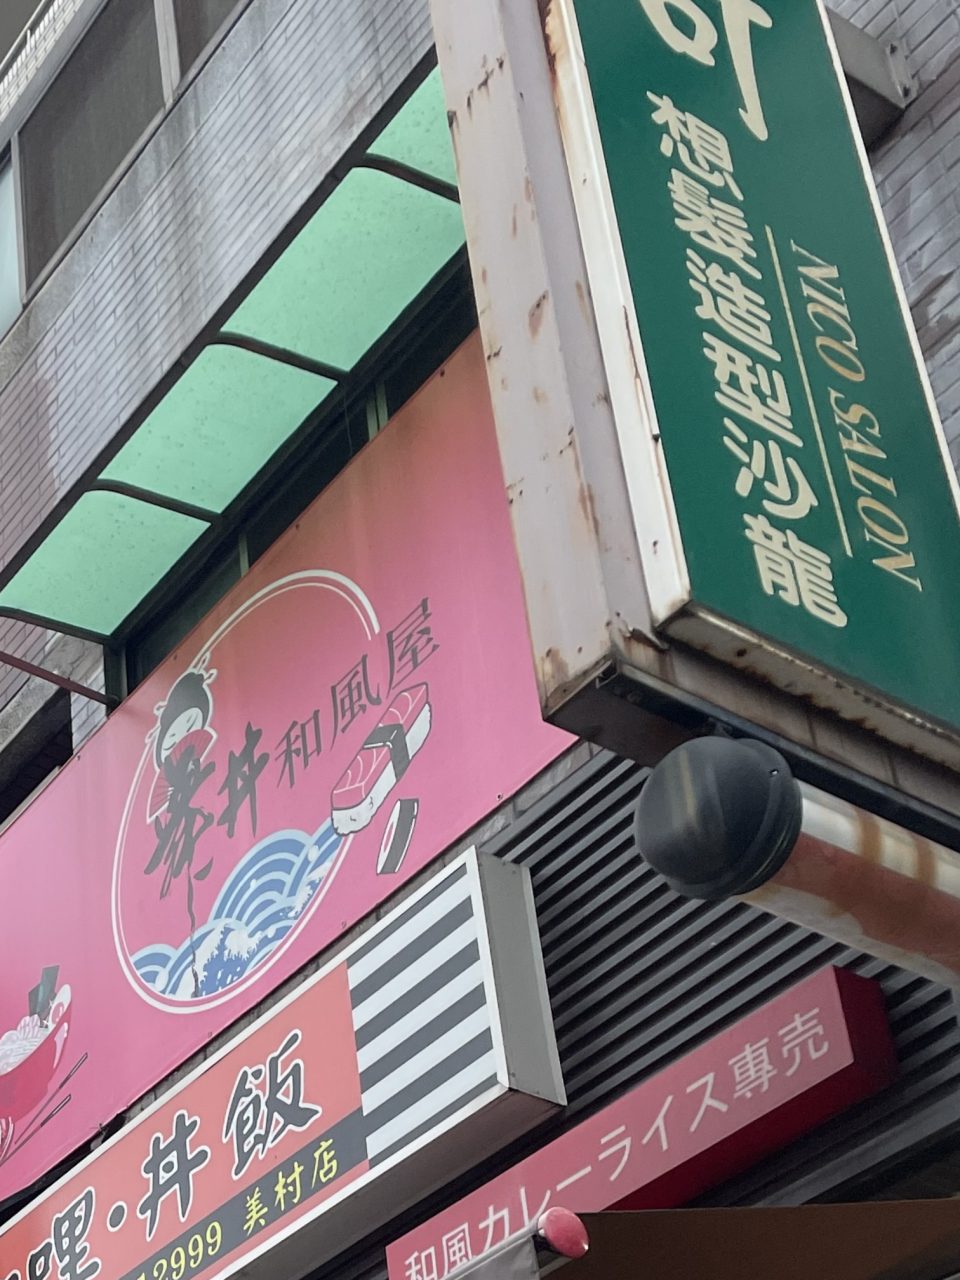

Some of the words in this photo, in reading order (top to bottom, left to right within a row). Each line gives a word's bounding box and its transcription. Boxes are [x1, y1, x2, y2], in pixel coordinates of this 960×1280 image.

[647, 91, 848, 627] 想髮造型沙龍
[790, 238, 866, 383] NICO
[826, 386, 923, 593] SALON
[242, 1138, 340, 1237] 美村店
